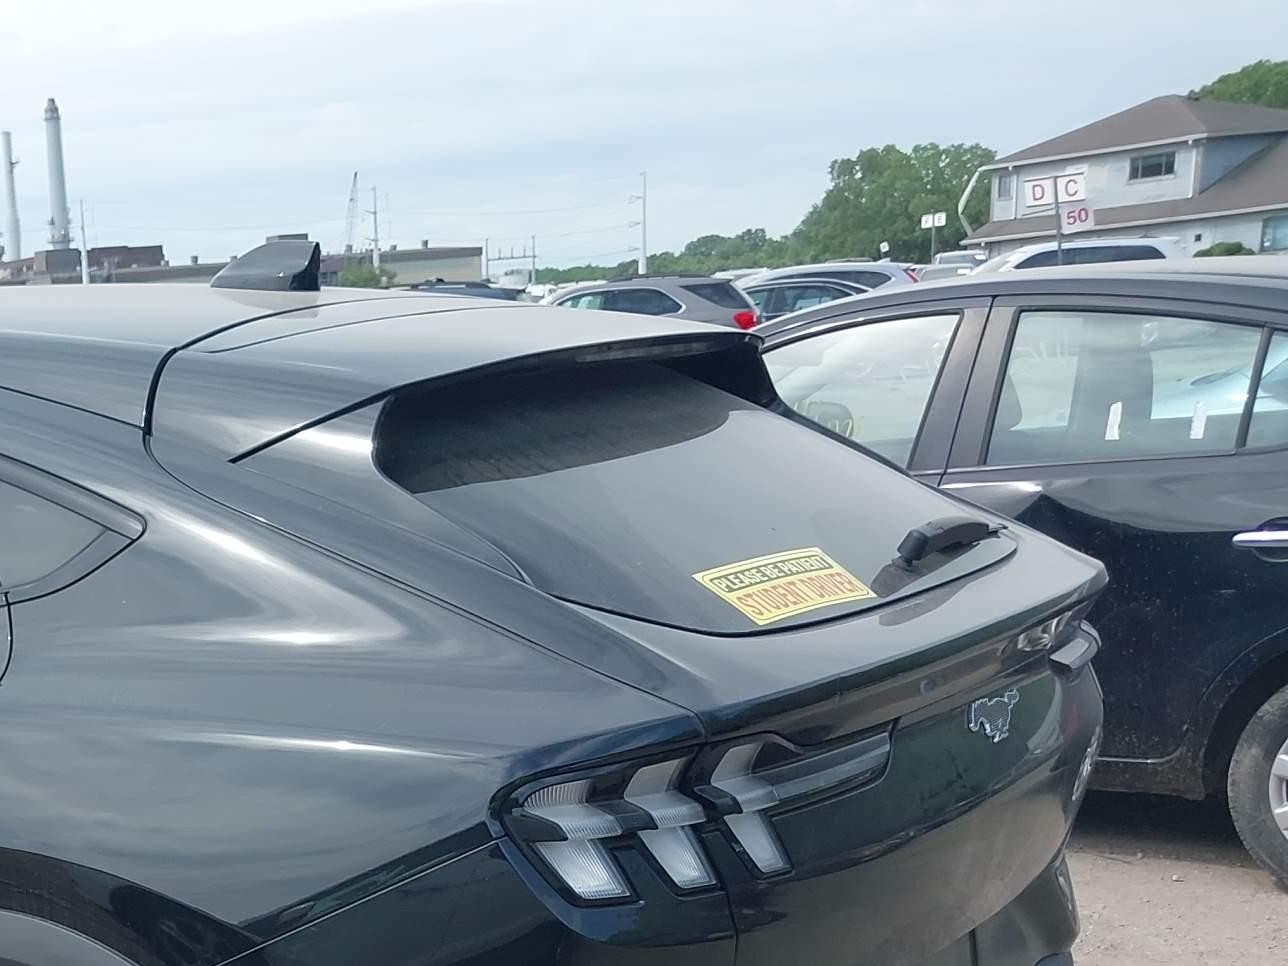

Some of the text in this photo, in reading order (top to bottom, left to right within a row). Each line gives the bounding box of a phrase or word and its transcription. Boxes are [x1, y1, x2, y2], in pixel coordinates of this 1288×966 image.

[1032, 184, 1045, 201] D
[1065, 179, 1079, 197] C
[1067, 208, 1089, 226] 50
[713, 556, 829, 592] PLEASE BE PATIENT
[736, 572, 865, 616] STUDENT DRIVER
